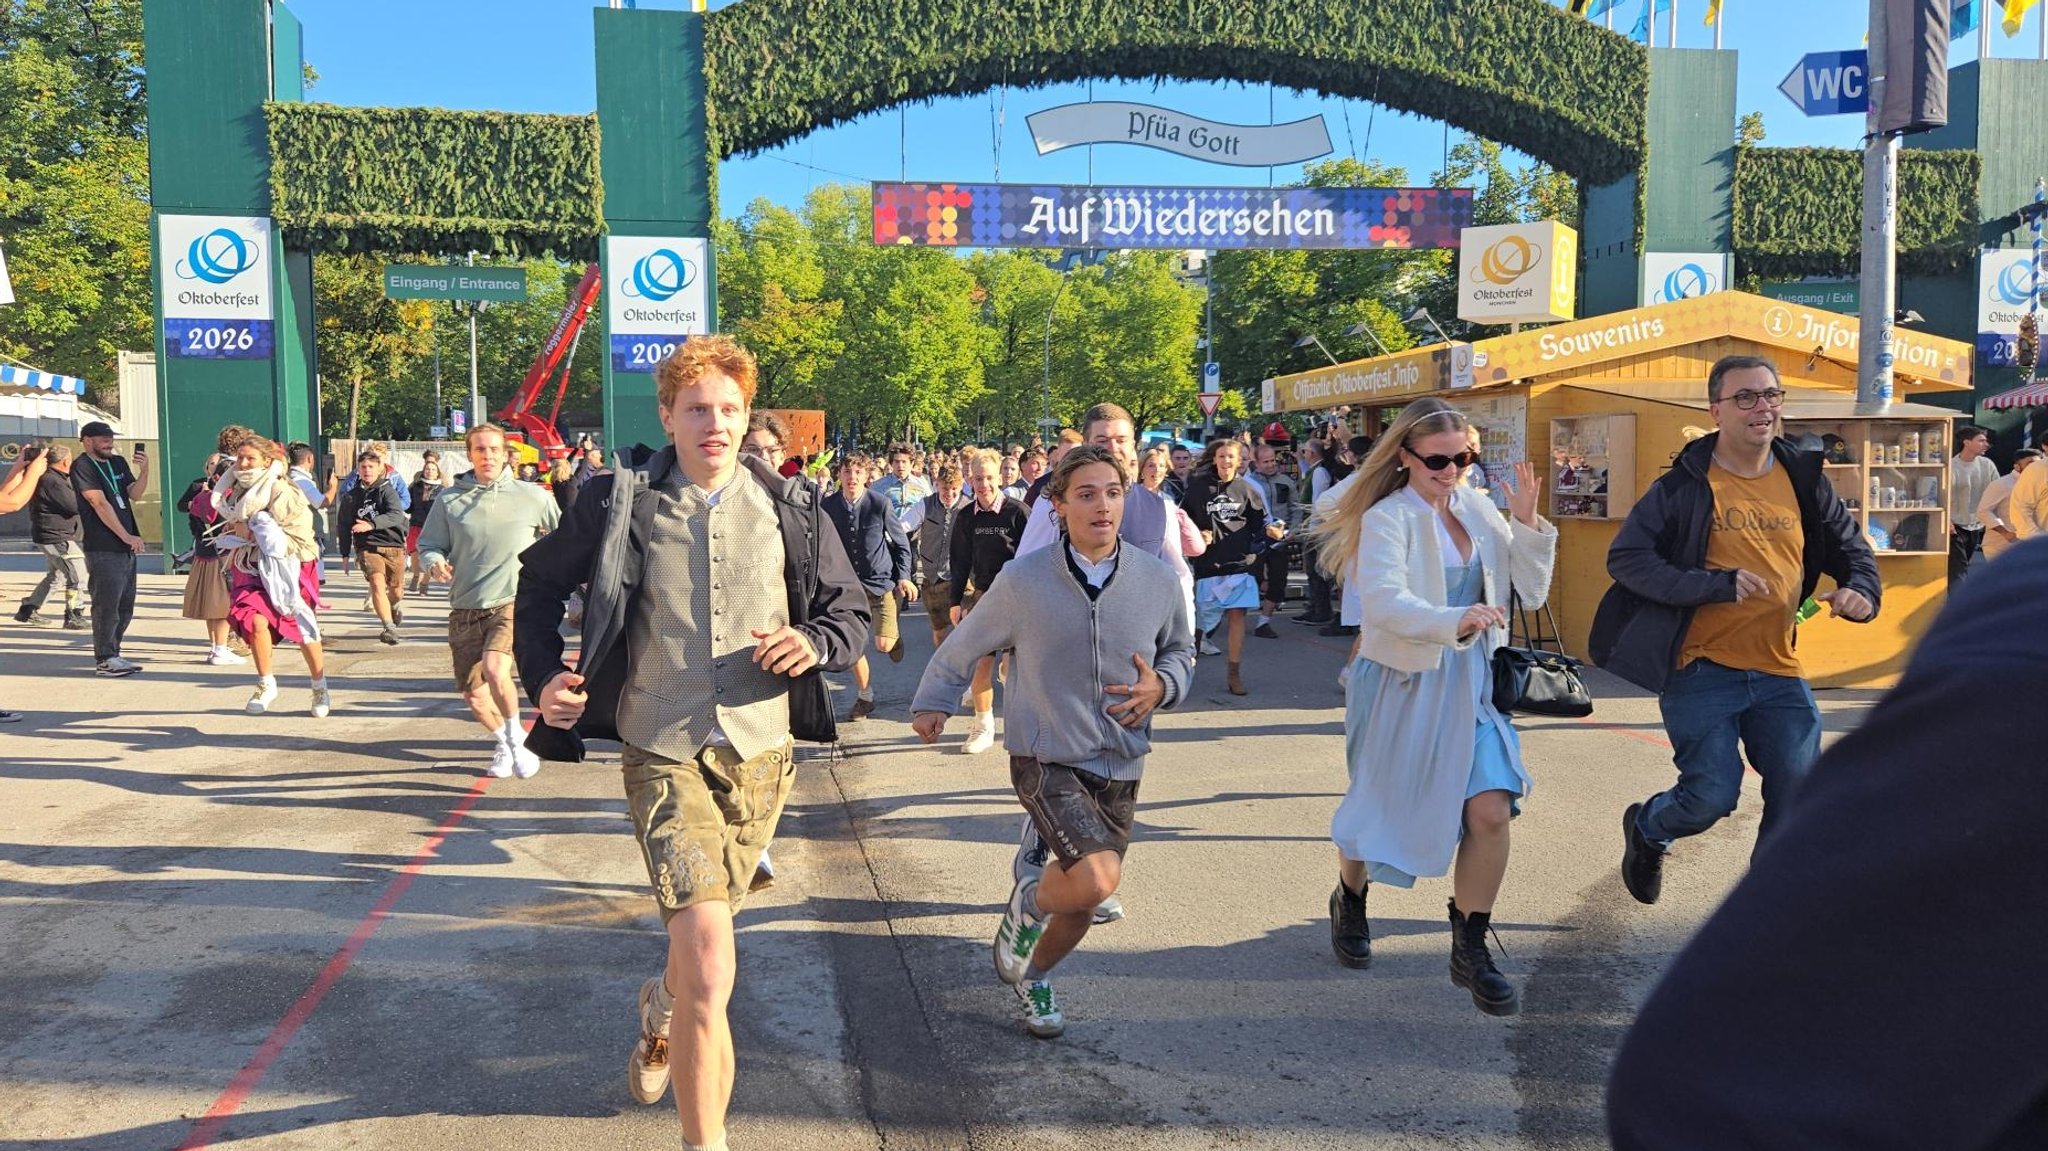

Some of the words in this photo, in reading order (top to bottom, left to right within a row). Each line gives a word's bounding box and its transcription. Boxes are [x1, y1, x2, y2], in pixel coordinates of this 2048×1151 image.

[1806, 65, 1863, 101] WC
[1128, 111, 1180, 142] Pfüa
[1188, 127, 1240, 155] Gott
[1021, 196, 1097, 244] Auf
[1102, 197, 1335, 236] Wiedersehen
[390, 275, 448, 291] Eingang
[451, 277, 456, 289] /
[459, 277, 520, 290] Entrance
[1473, 287, 1533, 300] Oktoberfest
[178, 291, 259, 308] Oktoberfest
[1776, 293, 1823, 305] Ausgang
[1833, 292, 1854, 303] Exit
[623, 308, 696, 324] Oktoberfest
[1989, 311, 2044, 323] Oktobst
[188, 327, 253, 350] 2026
[1539, 316, 1664, 360] Souvenirs
[1796, 313, 1937, 368] Infortion
[632, 343, 676, 364] 202
[1993, 341, 2015, 360] 20
[1293, 376, 1331, 404] Offizielle
[1333, 367, 1393, 395] Oktoberfest
[1393, 361, 1419, 390] Info
[1712, 507, 1799, 532] s.Oliver
